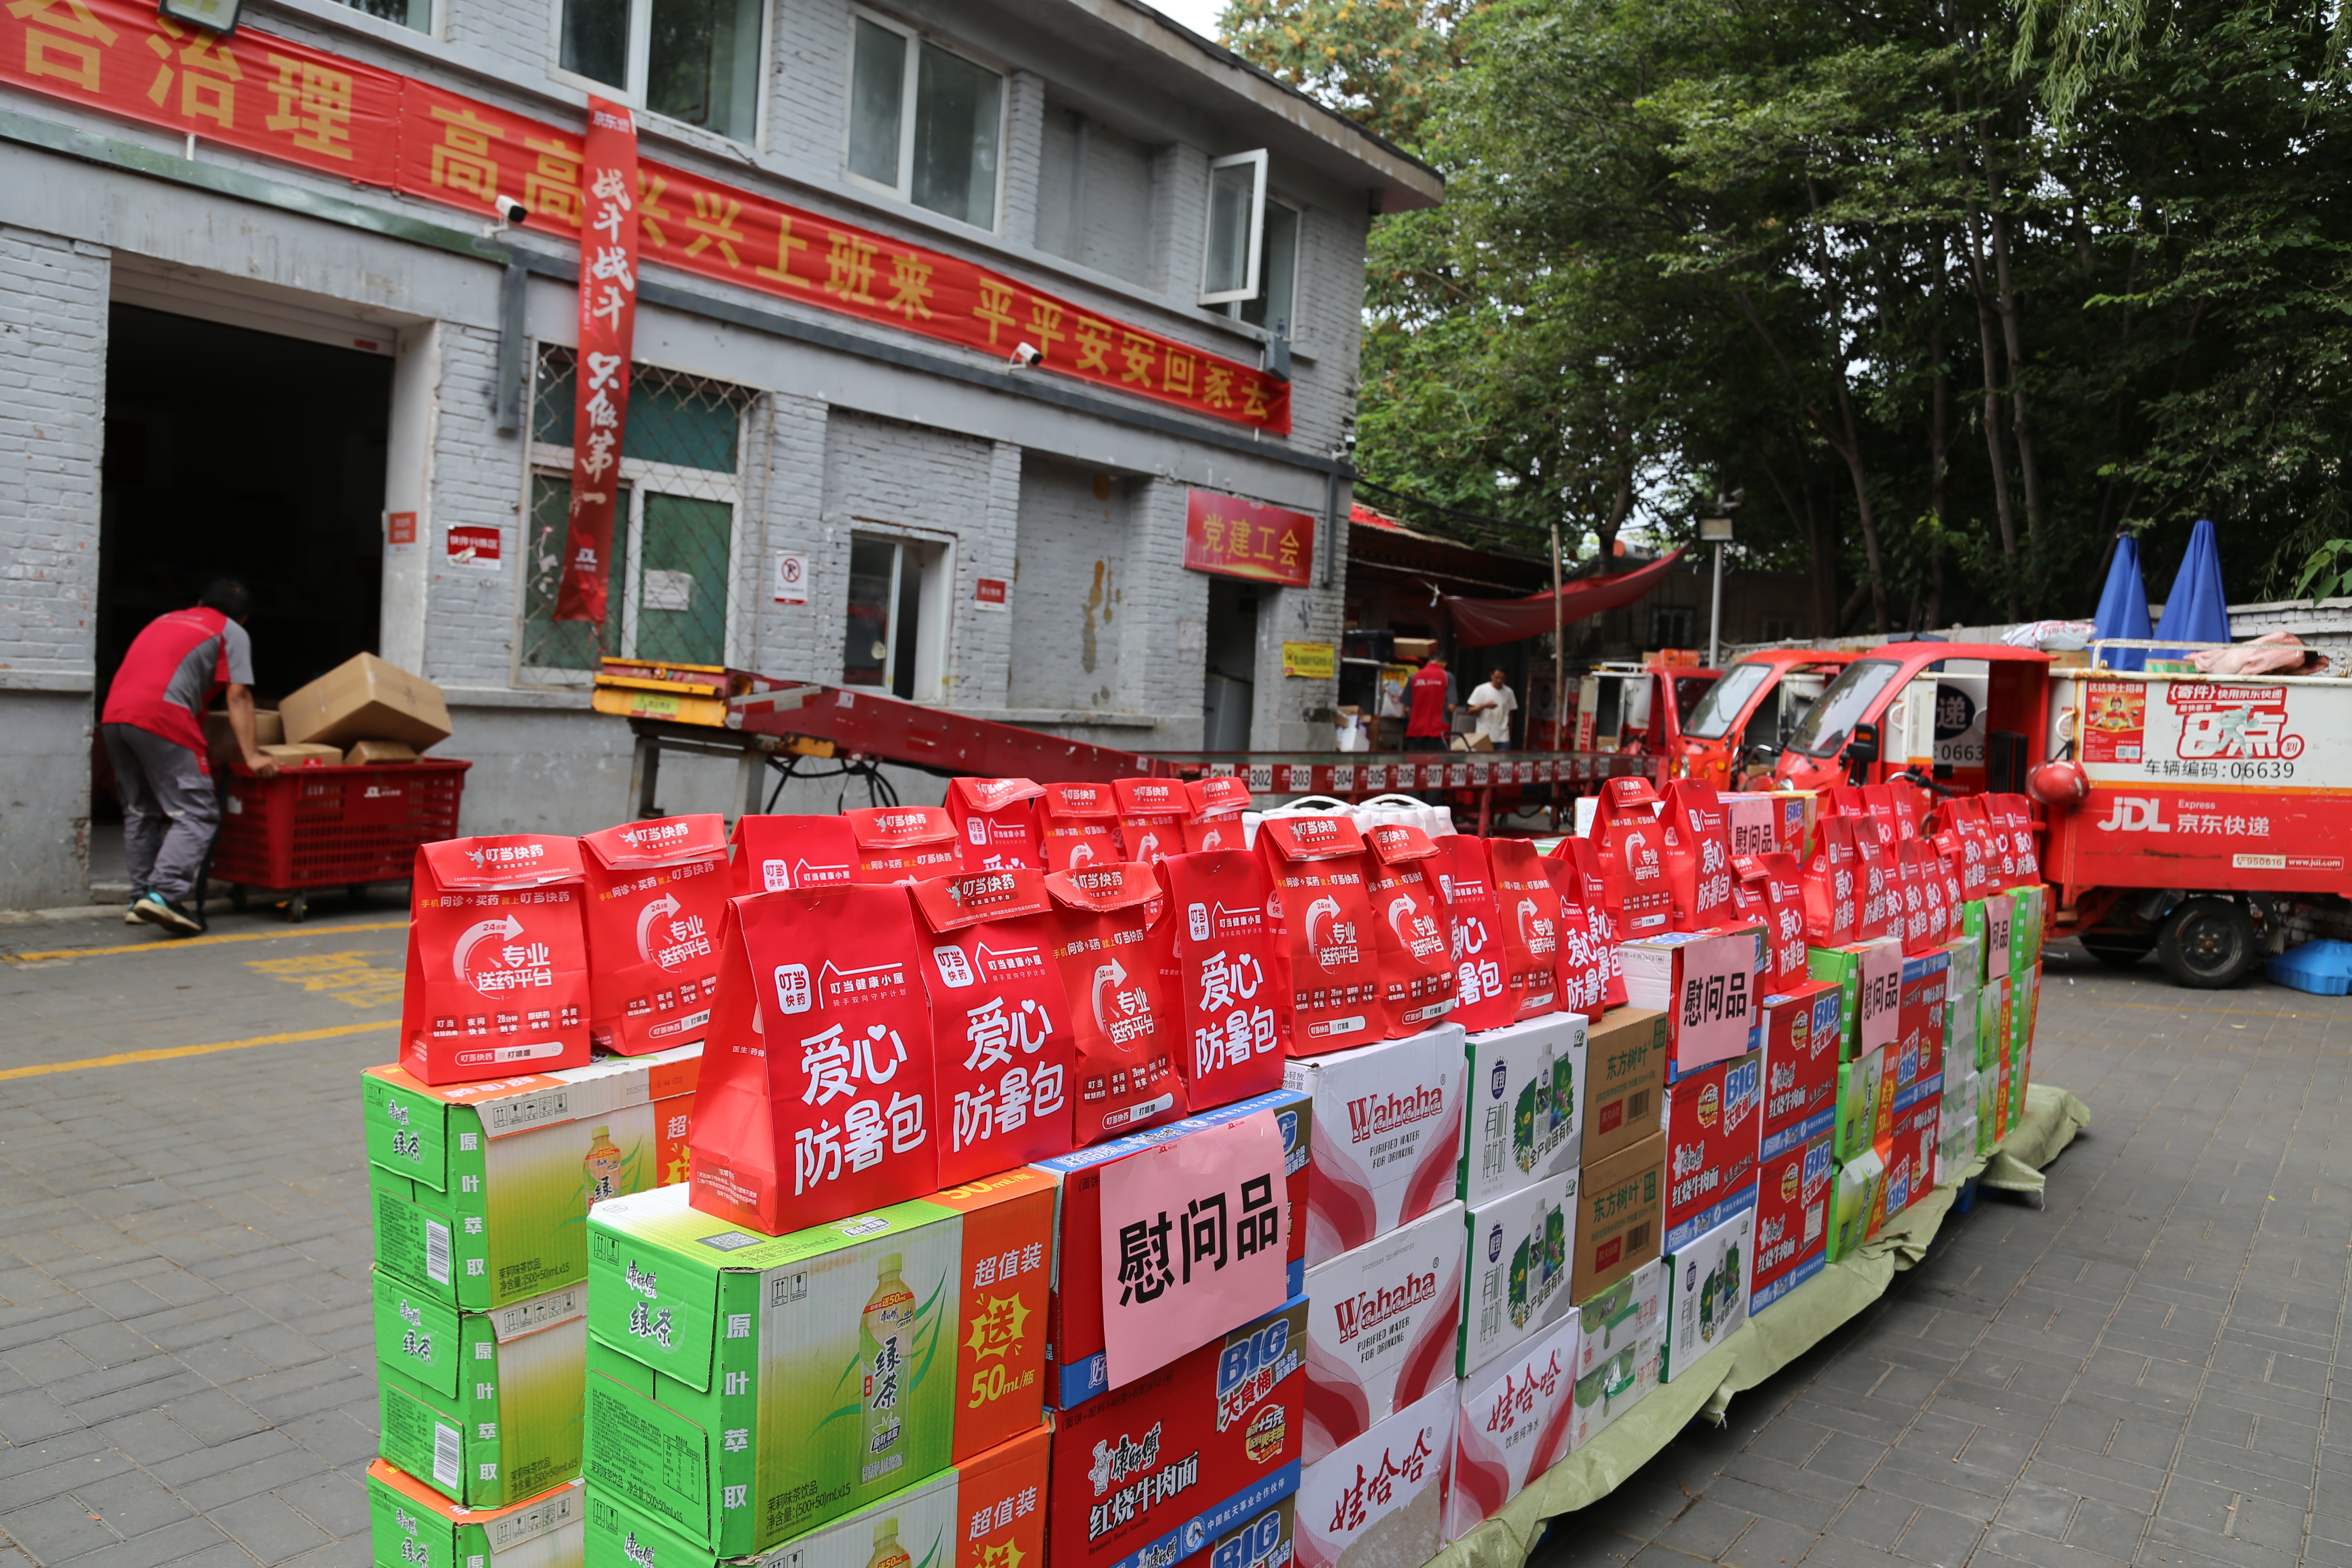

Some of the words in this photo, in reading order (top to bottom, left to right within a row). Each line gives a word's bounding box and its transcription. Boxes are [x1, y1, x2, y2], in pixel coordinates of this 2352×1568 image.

[5, 0, 352, 160] 合治理
[973, 277, 1270, 420] 平平安安回家去
[591, 168, 635, 333] 战斗战斗
[580, 350, 622, 505] 只做第一
[1203, 513, 1299, 567] 党建工会
[575, 548, 598, 564] JDL
[2179, 704, 2212, 712] 最快明早
[2217, 689, 2283, 700] 快用京东快递
[1936, 696, 1966, 729] 递
[2285, 741, 2298, 753] 到
[1250, 769, 1271, 787] 302
[1291, 770, 1311, 787] 303
[1335, 769, 1352, 785] 304
[1369, 769, 1385, 784] 305
[1398, 768, 1414, 784] 306
[1427, 768, 1442, 783] 307
[1785, 801, 1803, 822] BIG
[2097, 797, 2171, 833] JDL
[2178, 799, 2215, 810] Express
[636, 823, 689, 842] 叮当快药
[1298, 820, 1337, 836] 叮当快药
[1735, 824, 1773, 856] 慰问品
[2177, 814, 2270, 837] 京东快递
[486, 845, 544, 862] 叮当快药
[1702, 838, 1725, 875] 爱心
[2246, 857, 2283, 866] 950616
[2288, 858, 2340, 867] www.jdl.com
[963, 874, 1016, 896] 叮当快药
[1697, 873, 1730, 915] 防暑包
[971, 894, 1010, 906] 专业送药平台
[483, 923, 507, 932] 24小时
[670, 914, 706, 943] 专业
[1219, 915, 1261, 928] 叮当健康小屋
[1332, 922, 1357, 945] 专业
[1412, 914, 1438, 937] 专业
[502, 943, 551, 968] 专业
[658, 938, 711, 969] 送药平台
[940, 951, 965, 968] 叮当
[1320, 946, 1359, 966] 送药平台
[1410, 935, 1445, 958] 送药平台
[948, 969, 967, 981] 快药
[988, 955, 1043, 972] 叮当健康小屋
[993, 969, 1046, 983] 骑手双向守护计划
[476, 968, 552, 992] 送药平台
[779, 971, 806, 991] 叮当
[830, 971, 905, 995] 叮当健康小屋
[1200, 950, 1264, 1013] 爱心
[786, 992, 805, 1007] 快药
[833, 987, 907, 1008] 骑手双向守护计划
[1116, 986, 1151, 1016] 专业
[1683, 972, 1747, 1027] 慰问品
[1864, 972, 1899, 1021] 慰问品
[437, 1019, 454, 1028] 叮当
[467, 1017, 485, 1027] 夜间
[497, 1014, 518, 1024] 28分钟
[528, 1010, 551, 1021] 原研药
[531, 1020, 549, 1029] 保供
[561, 1008, 578, 1017] 免费
[562, 1017, 578, 1026] 问诊
[1813, 993, 1839, 1035] BIG
[433, 1029, 458, 1038] 智慧药房
[469, 1026, 487, 1035] 快送
[500, 1023, 518, 1033] 到家
[963, 995, 1053, 1072] 爱心
[1109, 1014, 1155, 1045] 送药平台
[1196, 1005, 1277, 1080] 防暑包
[507, 1049, 531, 1058] 打喷嚏
[800, 1022, 908, 1107] 爱心
[1606, 1042, 1648, 1081] 东方树叶
[1112, 1072, 1125, 1084] 夜间
[1113, 1084, 1126, 1095] 快送
[1493, 1070, 1505, 1091] 极致
[1724, 1060, 1757, 1110] BIG
[953, 1061, 1064, 1153] 防暑包
[1347, 1084, 1443, 1144] Wahaha
[1769, 1085, 1807, 1120] 红烧牛肉面
[1485, 1101, 1508, 1142] 有机
[393, 1129, 420, 1161] 绿茶
[794, 1091, 927, 1197] 防暑包
[1053, 1145, 1119, 1167] 好品质
[1159, 1145, 1168, 1154] JDL
[1369, 1136, 1398, 1158] PURIFIED
[1400, 1130, 1420, 1146] WATER
[1529, 1117, 1573, 1169] 全产业链有机
[1372, 1155, 1386, 1170] FOR
[1388, 1146, 1414, 1166] DRINKING
[1482, 1138, 1506, 1179] 纯牛奶
[1802, 1140, 1831, 1186] BIG
[1672, 1164, 1719, 1208] 红烧牛肉面
[459, 1132, 485, 1277] 原叶萃取
[1593, 1182, 1640, 1225] 东方树叶
[1117, 1173, 1280, 1307] 慰问品
[498, 1258, 542, 1280] 茉莉味茶饮品
[973, 1242, 1042, 1290] 超值装
[1757, 1236, 1796, 1274] 红烧牛肉面
[1483, 1264, 1504, 1305] 有机
[1522, 1272, 1564, 1324] 全产业链有机
[1335, 1272, 1436, 1344] Wahaha
[1480, 1298, 1502, 1341] 纯牛奶
[629, 1301, 673, 1348] 绿茶
[978, 1303, 1014, 1353] 送
[1357, 1327, 1387, 1352] PURIFIED
[1389, 1317, 1410, 1334] WATER
[1217, 1318, 1289, 1399] BIG
[1361, 1348, 1375, 1363] FOR
[1377, 1334, 1404, 1356] DRINKING
[873, 1335, 901, 1409] 绿茶
[1275, 1358, 1298, 1381] 超满足
[968, 1363, 1035, 1409] 50mL/瓶
[1217, 1367, 1272, 1432] 大食桶
[1487, 1349, 1562, 1433] 娃哈哈
[475, 1342, 498, 1481] 原叶萃取
[723, 1314, 751, 1509] 原叶萃取
[1246, 1406, 1285, 1439] 面饼+5克
[1505, 1417, 1539, 1450] 饮用纯净水
[510, 1456, 551, 1482] 茉莉味茶饮品
[1329, 1428, 1432, 1533] 娃哈哈
[767, 1479, 818, 1513] 茉莉味茶饮品
[1089, 1450, 1199, 1542] 红烧牛肉面
[1208, 1477, 1285, 1531] 中国航天事业合作伙伴
[968, 1485, 1038, 1542] 超值装
[1088, 1533, 1112, 1556] Braised
[1114, 1527, 1127, 1541] Beef
[1129, 1516, 1150, 1535] Noodle
